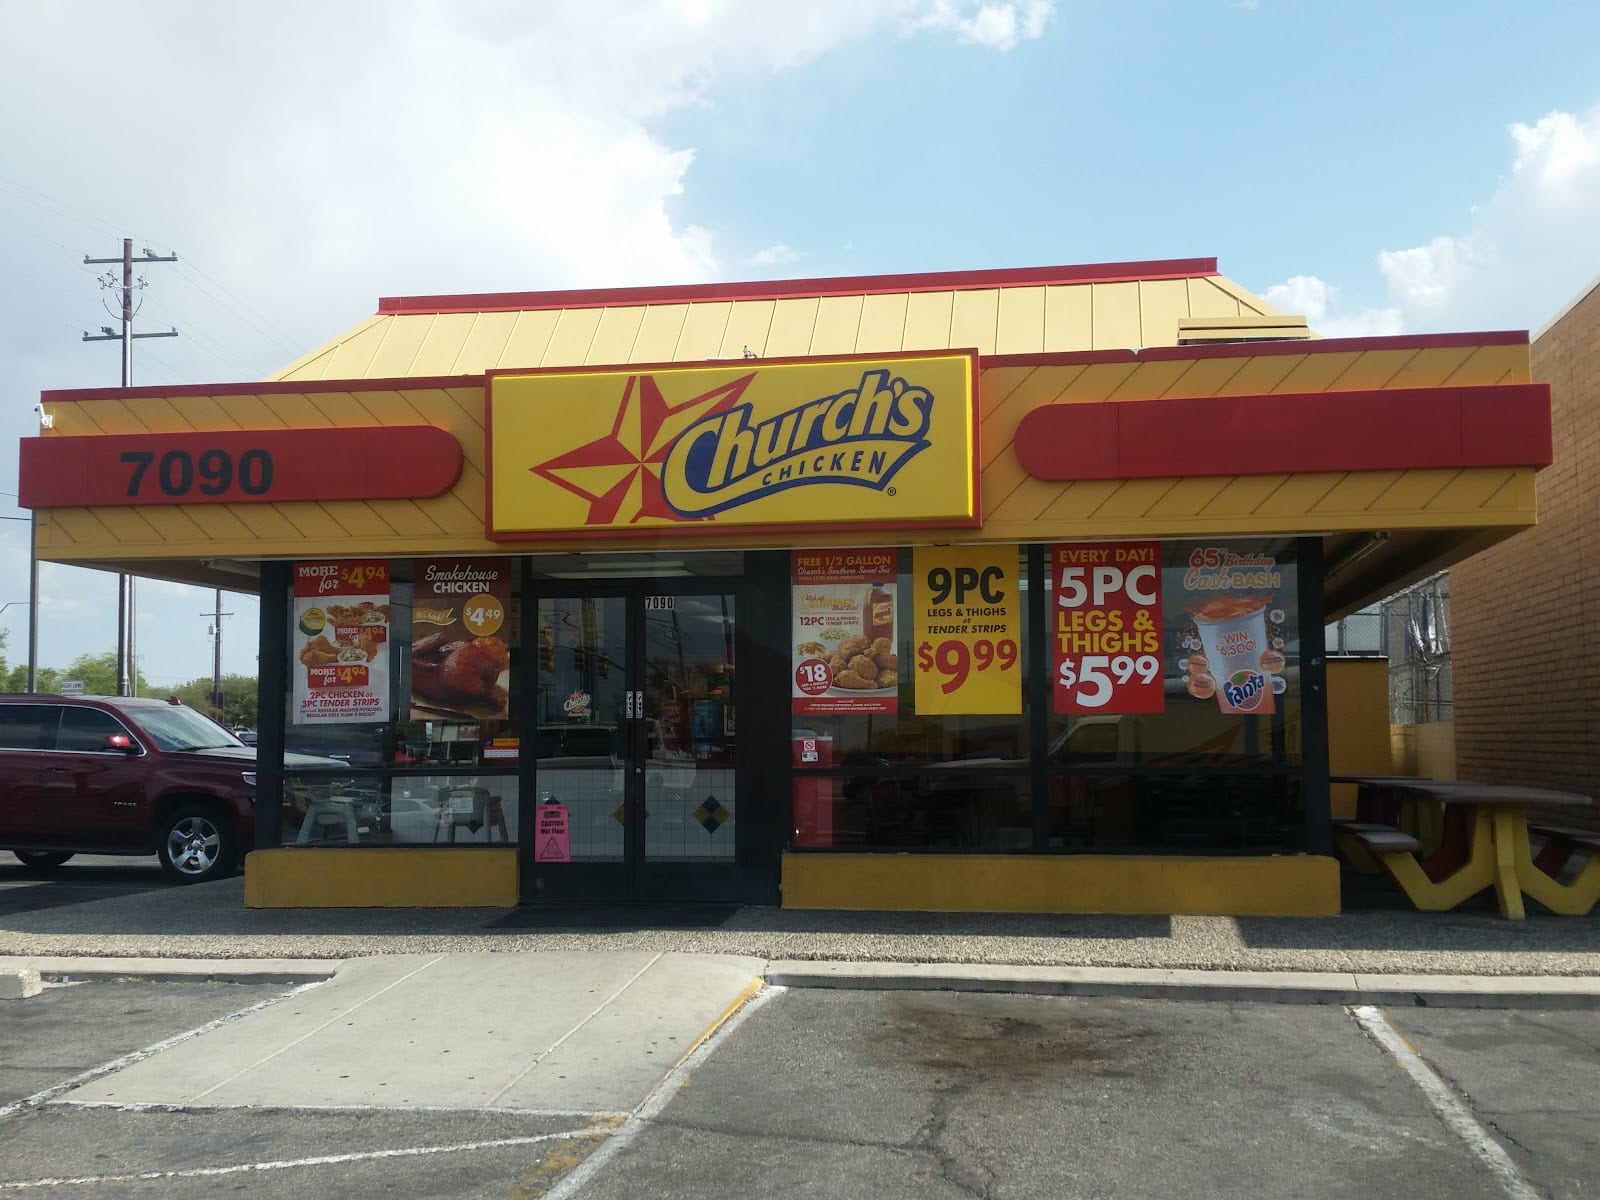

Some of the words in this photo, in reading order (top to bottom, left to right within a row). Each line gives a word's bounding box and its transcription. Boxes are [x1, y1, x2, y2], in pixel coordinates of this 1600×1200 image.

[662, 369, 933, 514] Church's
[119, 448, 274, 497] 7090
[762, 450, 888, 487] CHICKEN
[797, 557, 820, 567] FREE
[825, 556, 843, 566] 1/2
[846, 555, 891, 565] GALLON
[1059, 549, 1108, 563] EVERY
[1115, 548, 1155, 562] DAY!
[1223, 553, 1275, 571] Birthday
[298, 565, 338, 577] MORE
[425, 564, 499, 581] Smokehouse
[1184, 567, 1231, 590] Cash
[1231, 572, 1280, 589] BASH
[318, 574, 340, 593] for
[433, 581, 490, 593] CHICKEN
[927, 566, 1005, 606] 9PC
[1058, 564, 1157, 608] 5PC
[646, 597, 674, 609] 7090
[927, 608, 953, 617] LEGS
[955, 607, 964, 617] &
[965, 607, 1007, 616] THIGHS
[799, 616, 825, 626] 12PC
[1058, 610, 1124, 632] LEGS
[1132, 609, 1155, 632] &
[927, 625, 968, 634] TENDER
[971, 624, 1007, 633] STRIPS
[1224, 631, 1249, 643] WIN
[1057, 631, 1159, 654] THIGHS
[310, 668, 336, 676] MORE
[800, 664, 827, 682] $18
[323, 675, 337, 686] for
[310, 691, 326, 699] 2PC
[328, 690, 365, 698] CHICKEN
[1223, 674, 1265, 707] Fanta
[302, 700, 318, 708] 3PC
[319, 699, 350, 707] TENDER
[352, 698, 380, 706] STRIPS
